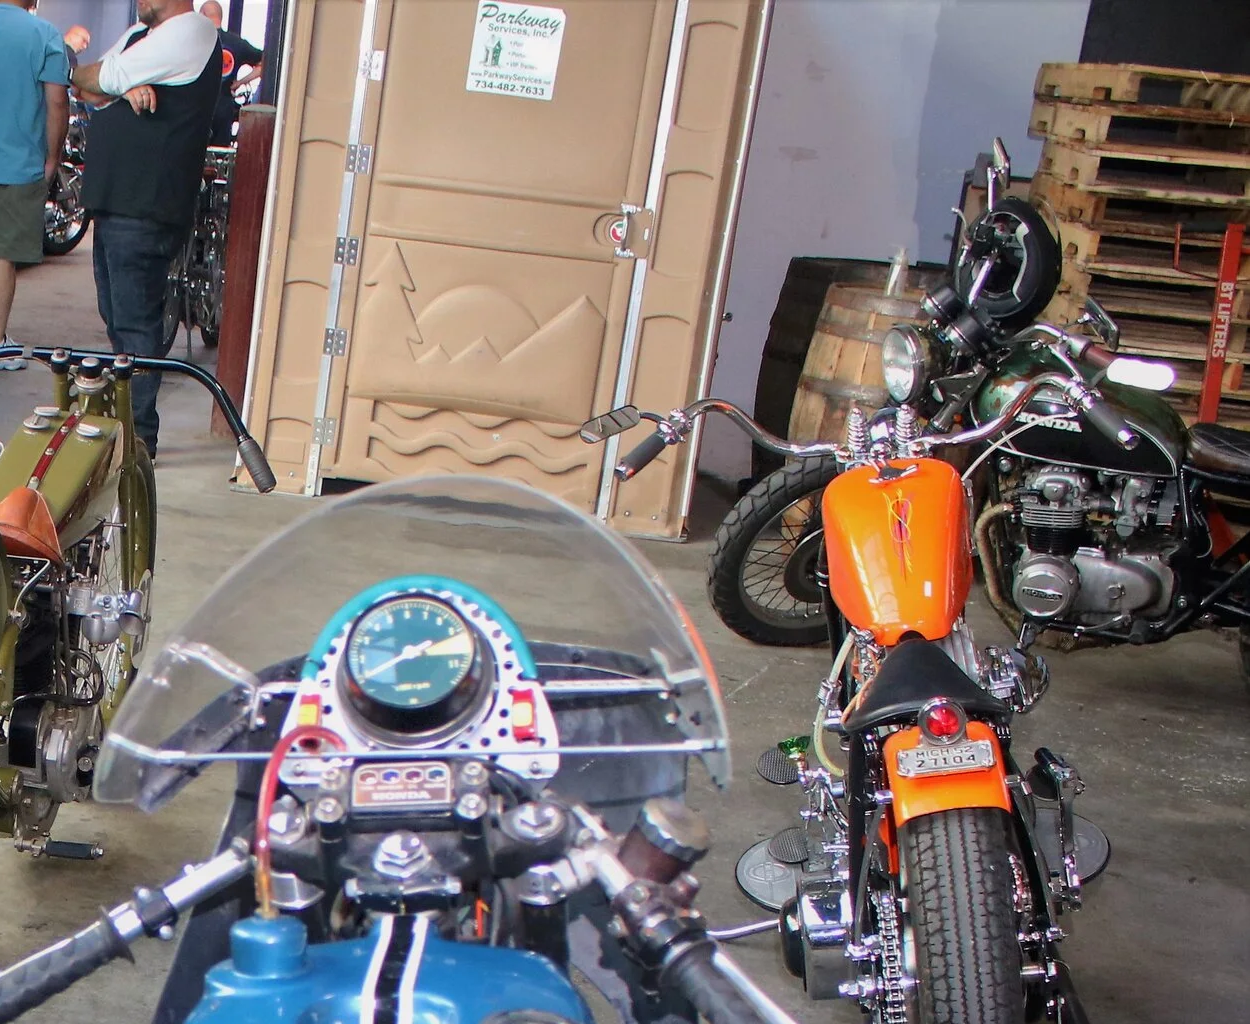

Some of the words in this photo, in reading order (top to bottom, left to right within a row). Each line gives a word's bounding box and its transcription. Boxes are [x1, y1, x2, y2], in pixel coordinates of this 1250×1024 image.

[480, 4, 561, 35] Parkway
[488, 23, 531, 37] Services,
[533, 28, 551, 38] Inc.
[475, 79, 545, 96] 734-482-7633
[1220, 282, 1235, 300] BT
[1212, 303, 1231, 358] LIFTERS
[916, 748, 950, 759] MICH
[916, 754, 975, 768] 27104
[371, 789, 431, 801] HONDA
